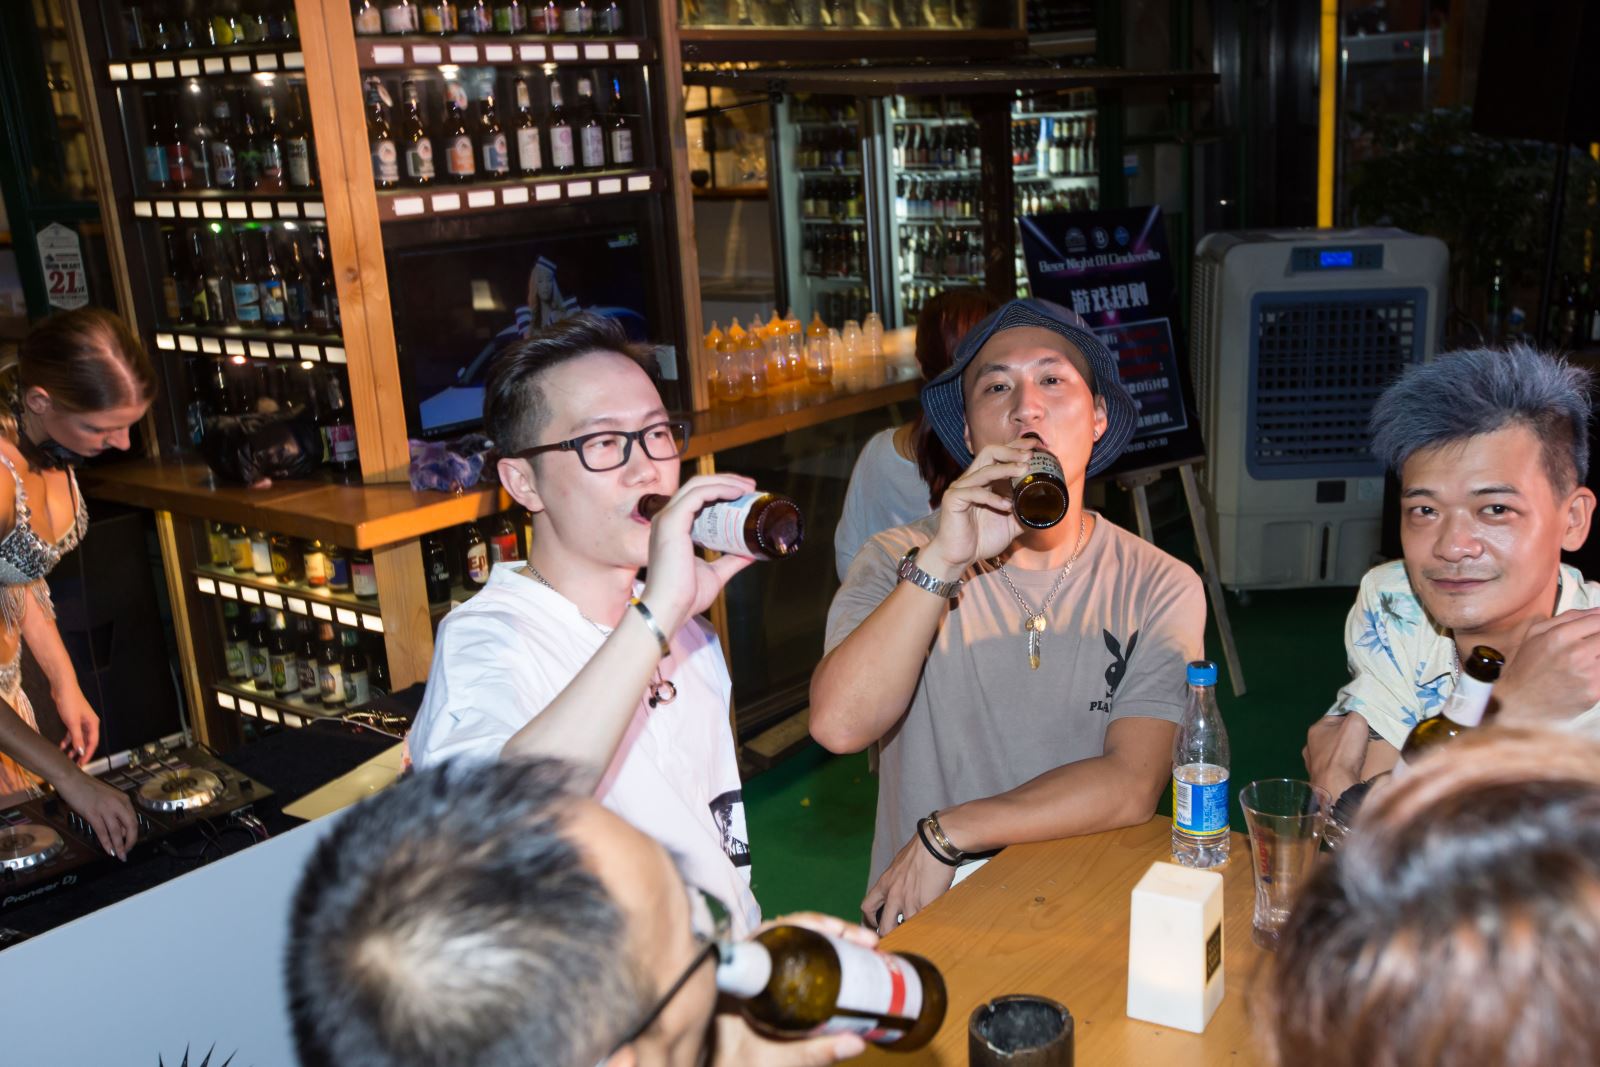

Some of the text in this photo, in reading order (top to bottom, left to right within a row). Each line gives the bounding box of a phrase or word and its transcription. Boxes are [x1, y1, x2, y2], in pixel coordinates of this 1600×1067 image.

[1039, 260, 1065, 273] Beer
[1066, 255, 1095, 272] Night
[1108, 248, 1161, 265] Cinderella
[1071, 281, 1149, 315] 游戏规则
[3, 874, 78, 907] Pioneer DJ
